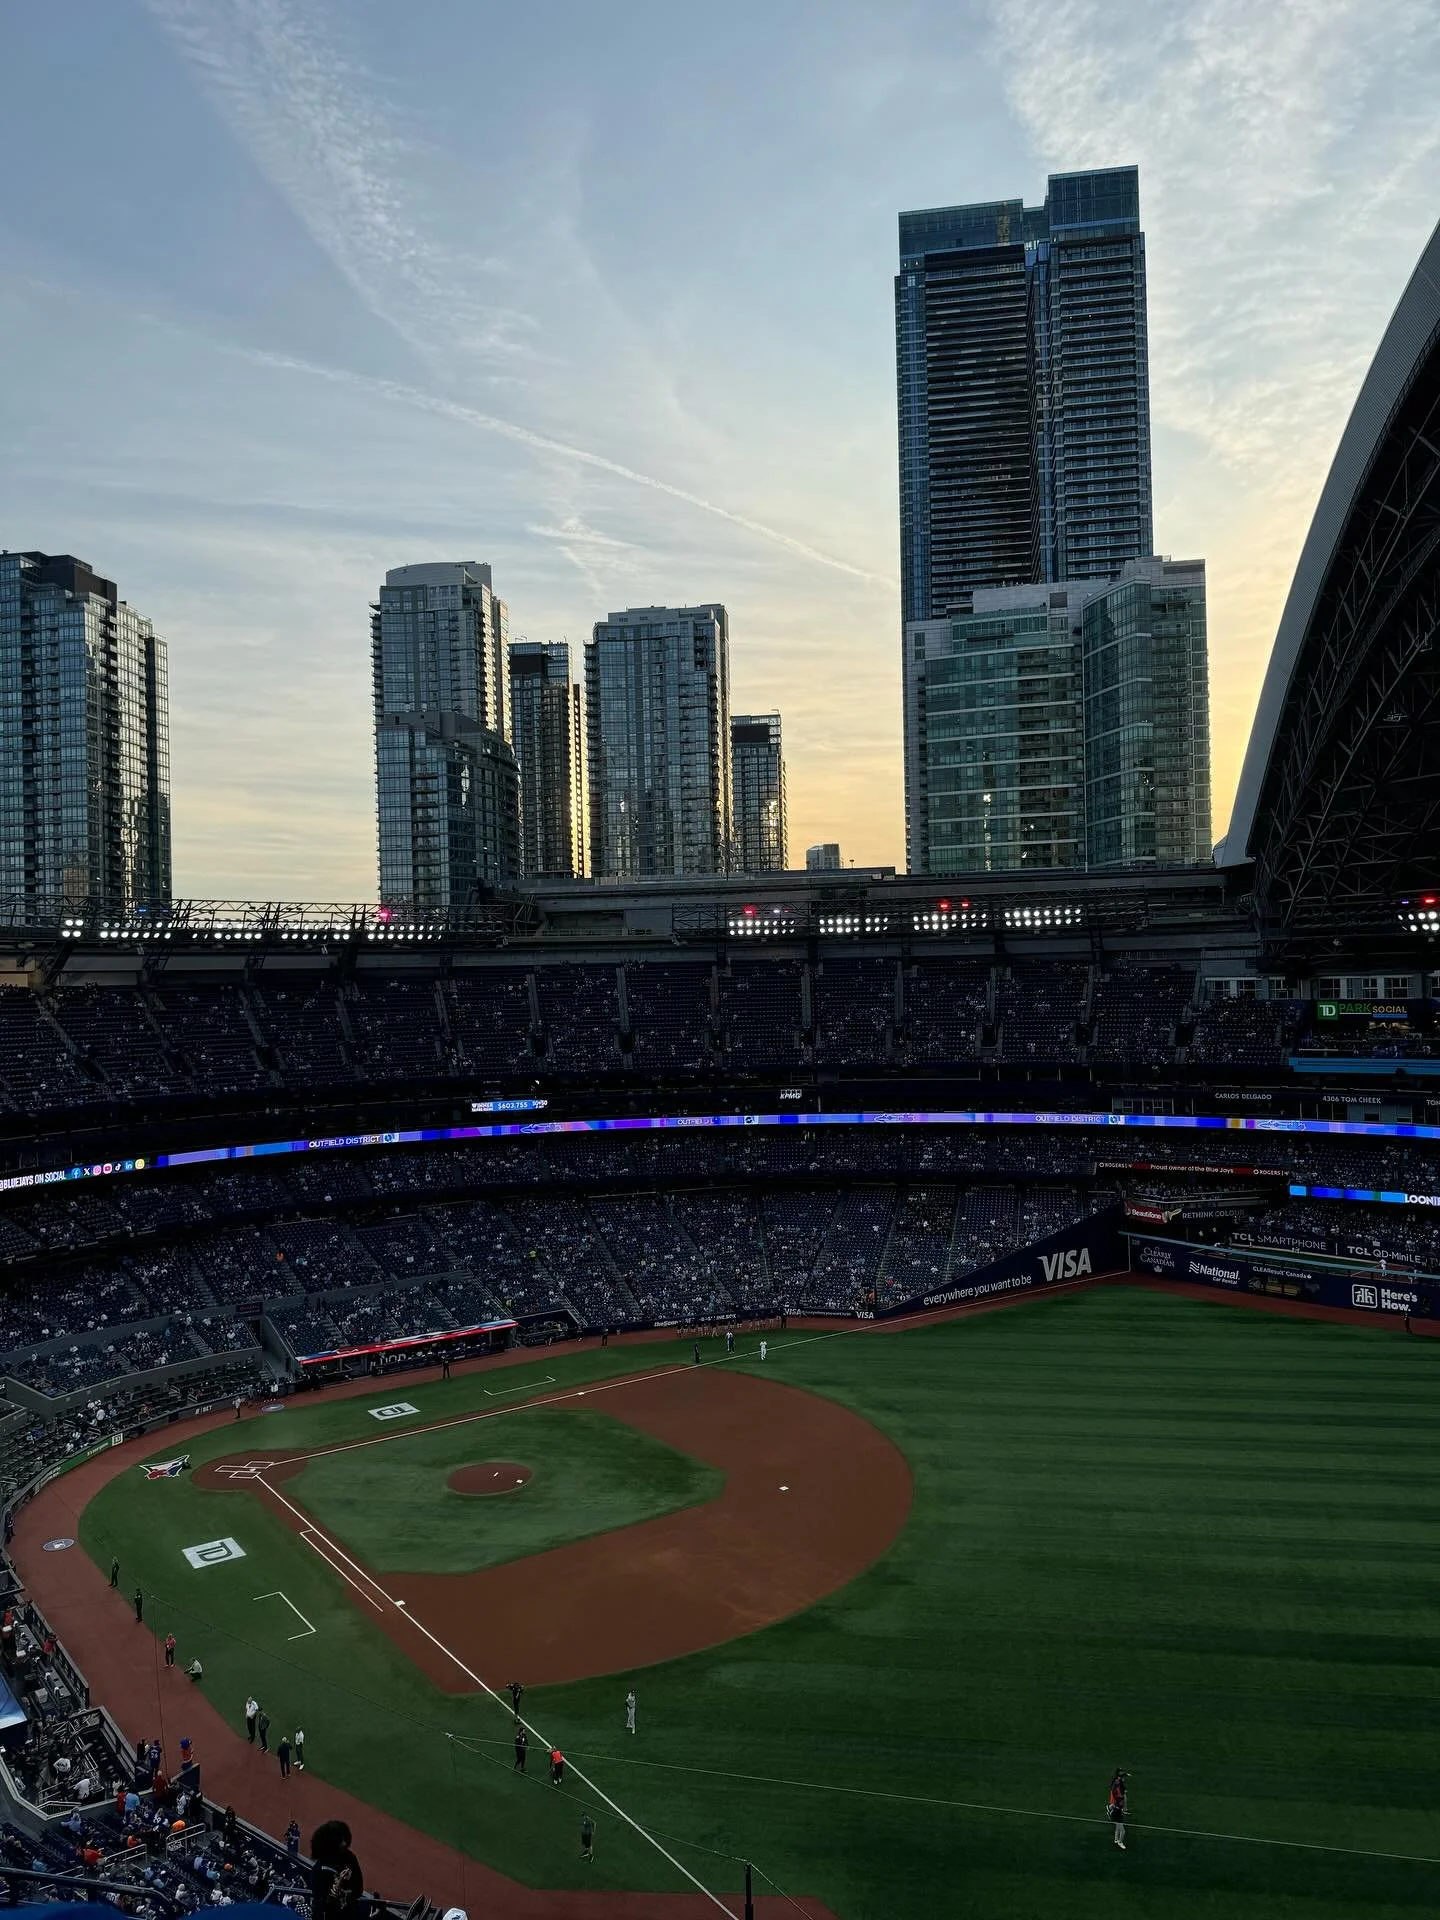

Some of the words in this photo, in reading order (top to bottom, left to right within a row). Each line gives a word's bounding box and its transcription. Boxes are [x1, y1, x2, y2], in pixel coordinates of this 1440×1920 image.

[1320, 1004, 1336, 1016] TD
[1340, 1003, 1372, 1012] PARK
[1373, 1005, 1407, 1013] SOCIAL
[780, 1089, 802, 1100] KPMG
[1071, 1115, 1105, 1123] DISTRICT
[309, 1139, 345, 1148] OUTFIELD
[346, 1136, 381, 1145] DISTRICT
[35, 1173, 44, 1184] ON
[45, 1171, 66, 1182] SOCIAL
[1215, 1209, 1245, 1217] COLOUR
[1232, 1233, 1254, 1241] TCL
[1257, 1235, 1327, 1250] SMARTPHONE
[1144, 1246, 1171, 1259] CLEARLY
[1347, 1246, 1371, 1256] TCL
[1037, 1248, 1092, 1281] VISA
[1140, 1254, 1175, 1267] CANADIAN
[923, 1286, 974, 1305] everywhere
[974, 1284, 990, 1297] you
[991, 1279, 1011, 1292] want
[1011, 1277, 1020, 1287] to
[1021, 1275, 1032, 1285] be
[1381, 1289, 1418, 1302] Here's
[1381, 1299, 1411, 1311] How.
[783, 1308, 801, 1316] VISA
[856, 1311, 875, 1319] VISA
[196, 1542, 232, 1561] TD
